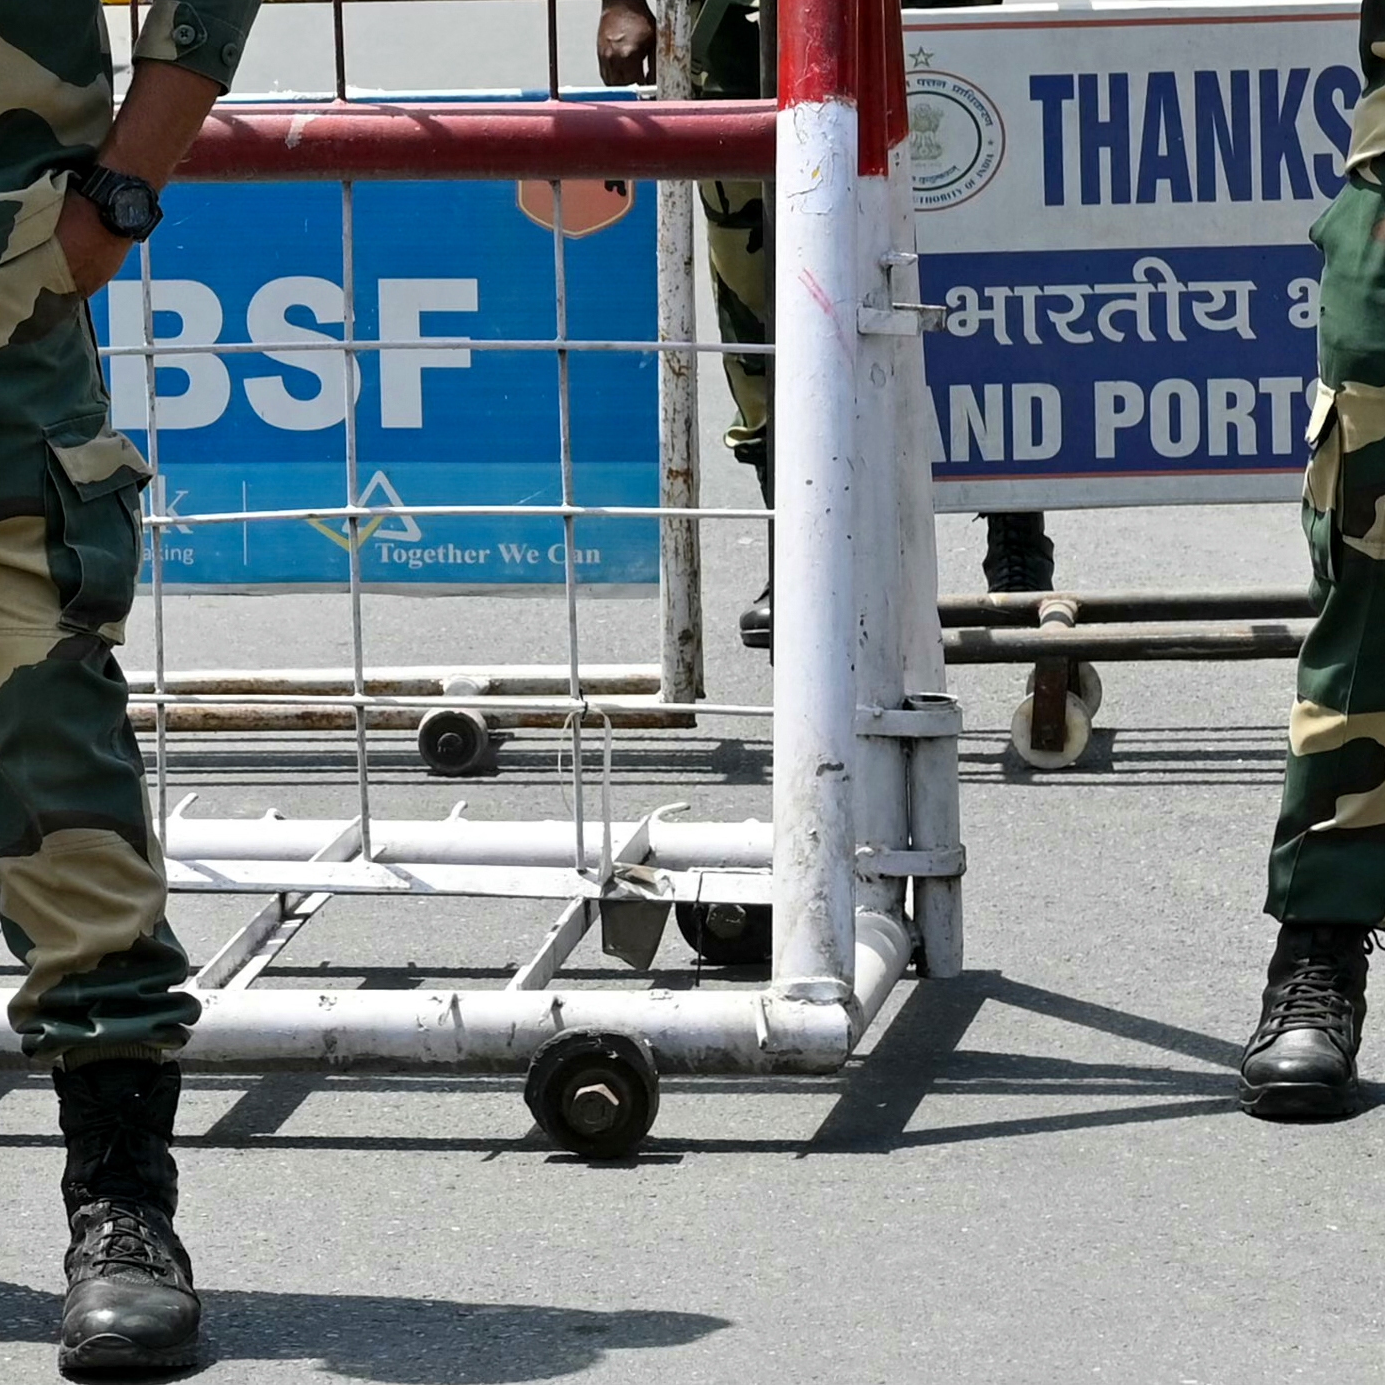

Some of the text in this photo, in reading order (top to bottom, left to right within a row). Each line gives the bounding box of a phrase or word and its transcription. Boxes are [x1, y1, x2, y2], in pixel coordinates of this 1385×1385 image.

[1030, 65, 1362, 207] THANKS
[945, 256, 1257, 346] भारतीय
[107, 275, 479, 431] BSF
[1094, 378, 1319, 459] PORT
[375, 542, 601, 569] Together We Can
